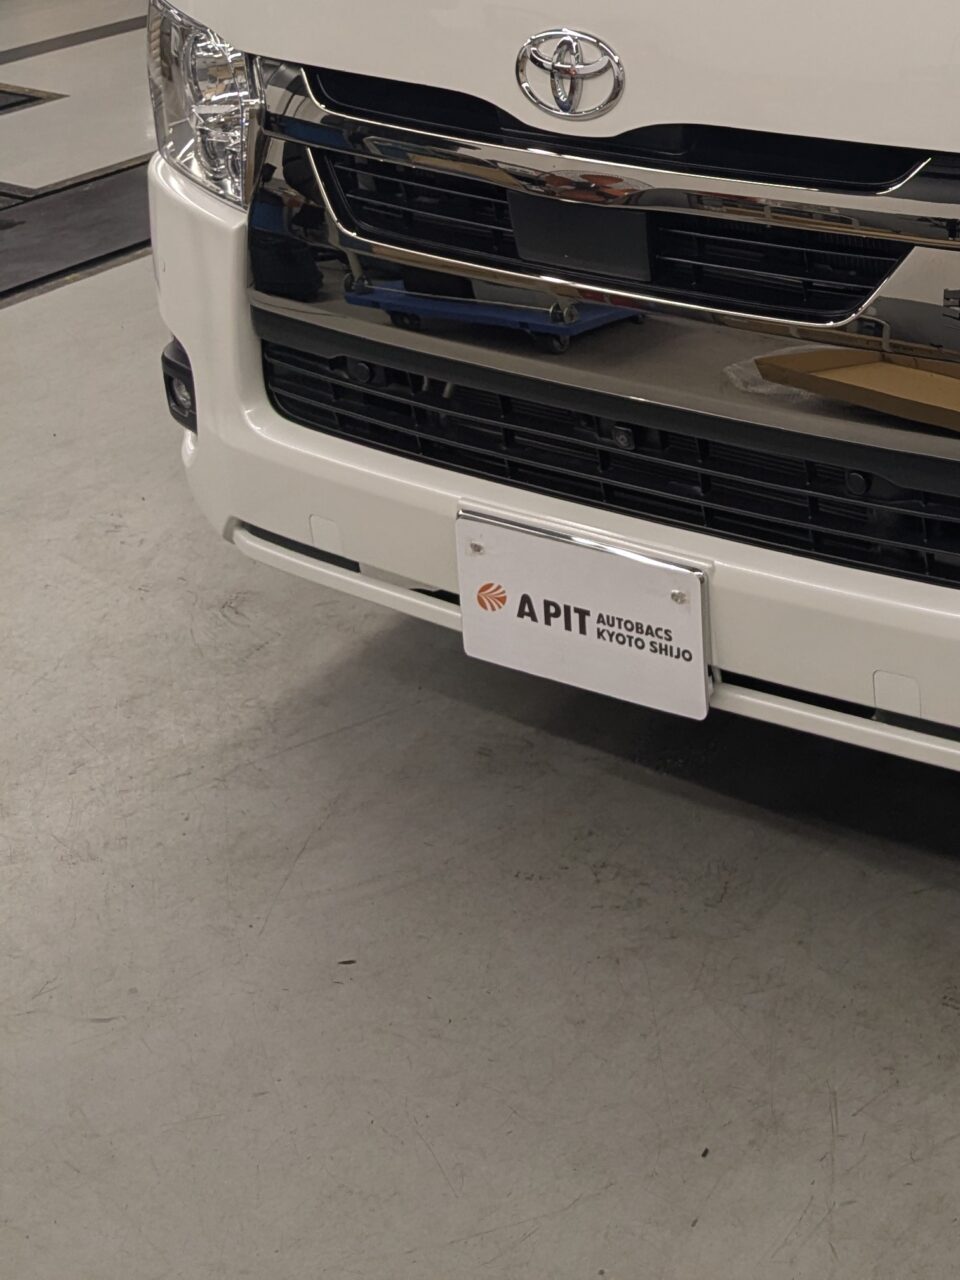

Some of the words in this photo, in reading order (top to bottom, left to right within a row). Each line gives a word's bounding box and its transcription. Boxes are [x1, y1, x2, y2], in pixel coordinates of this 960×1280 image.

[596, 612, 673, 642] AUTOBACS
[596, 627, 645, 650] KYOTO
[649, 640, 693, 662] SHIJO
